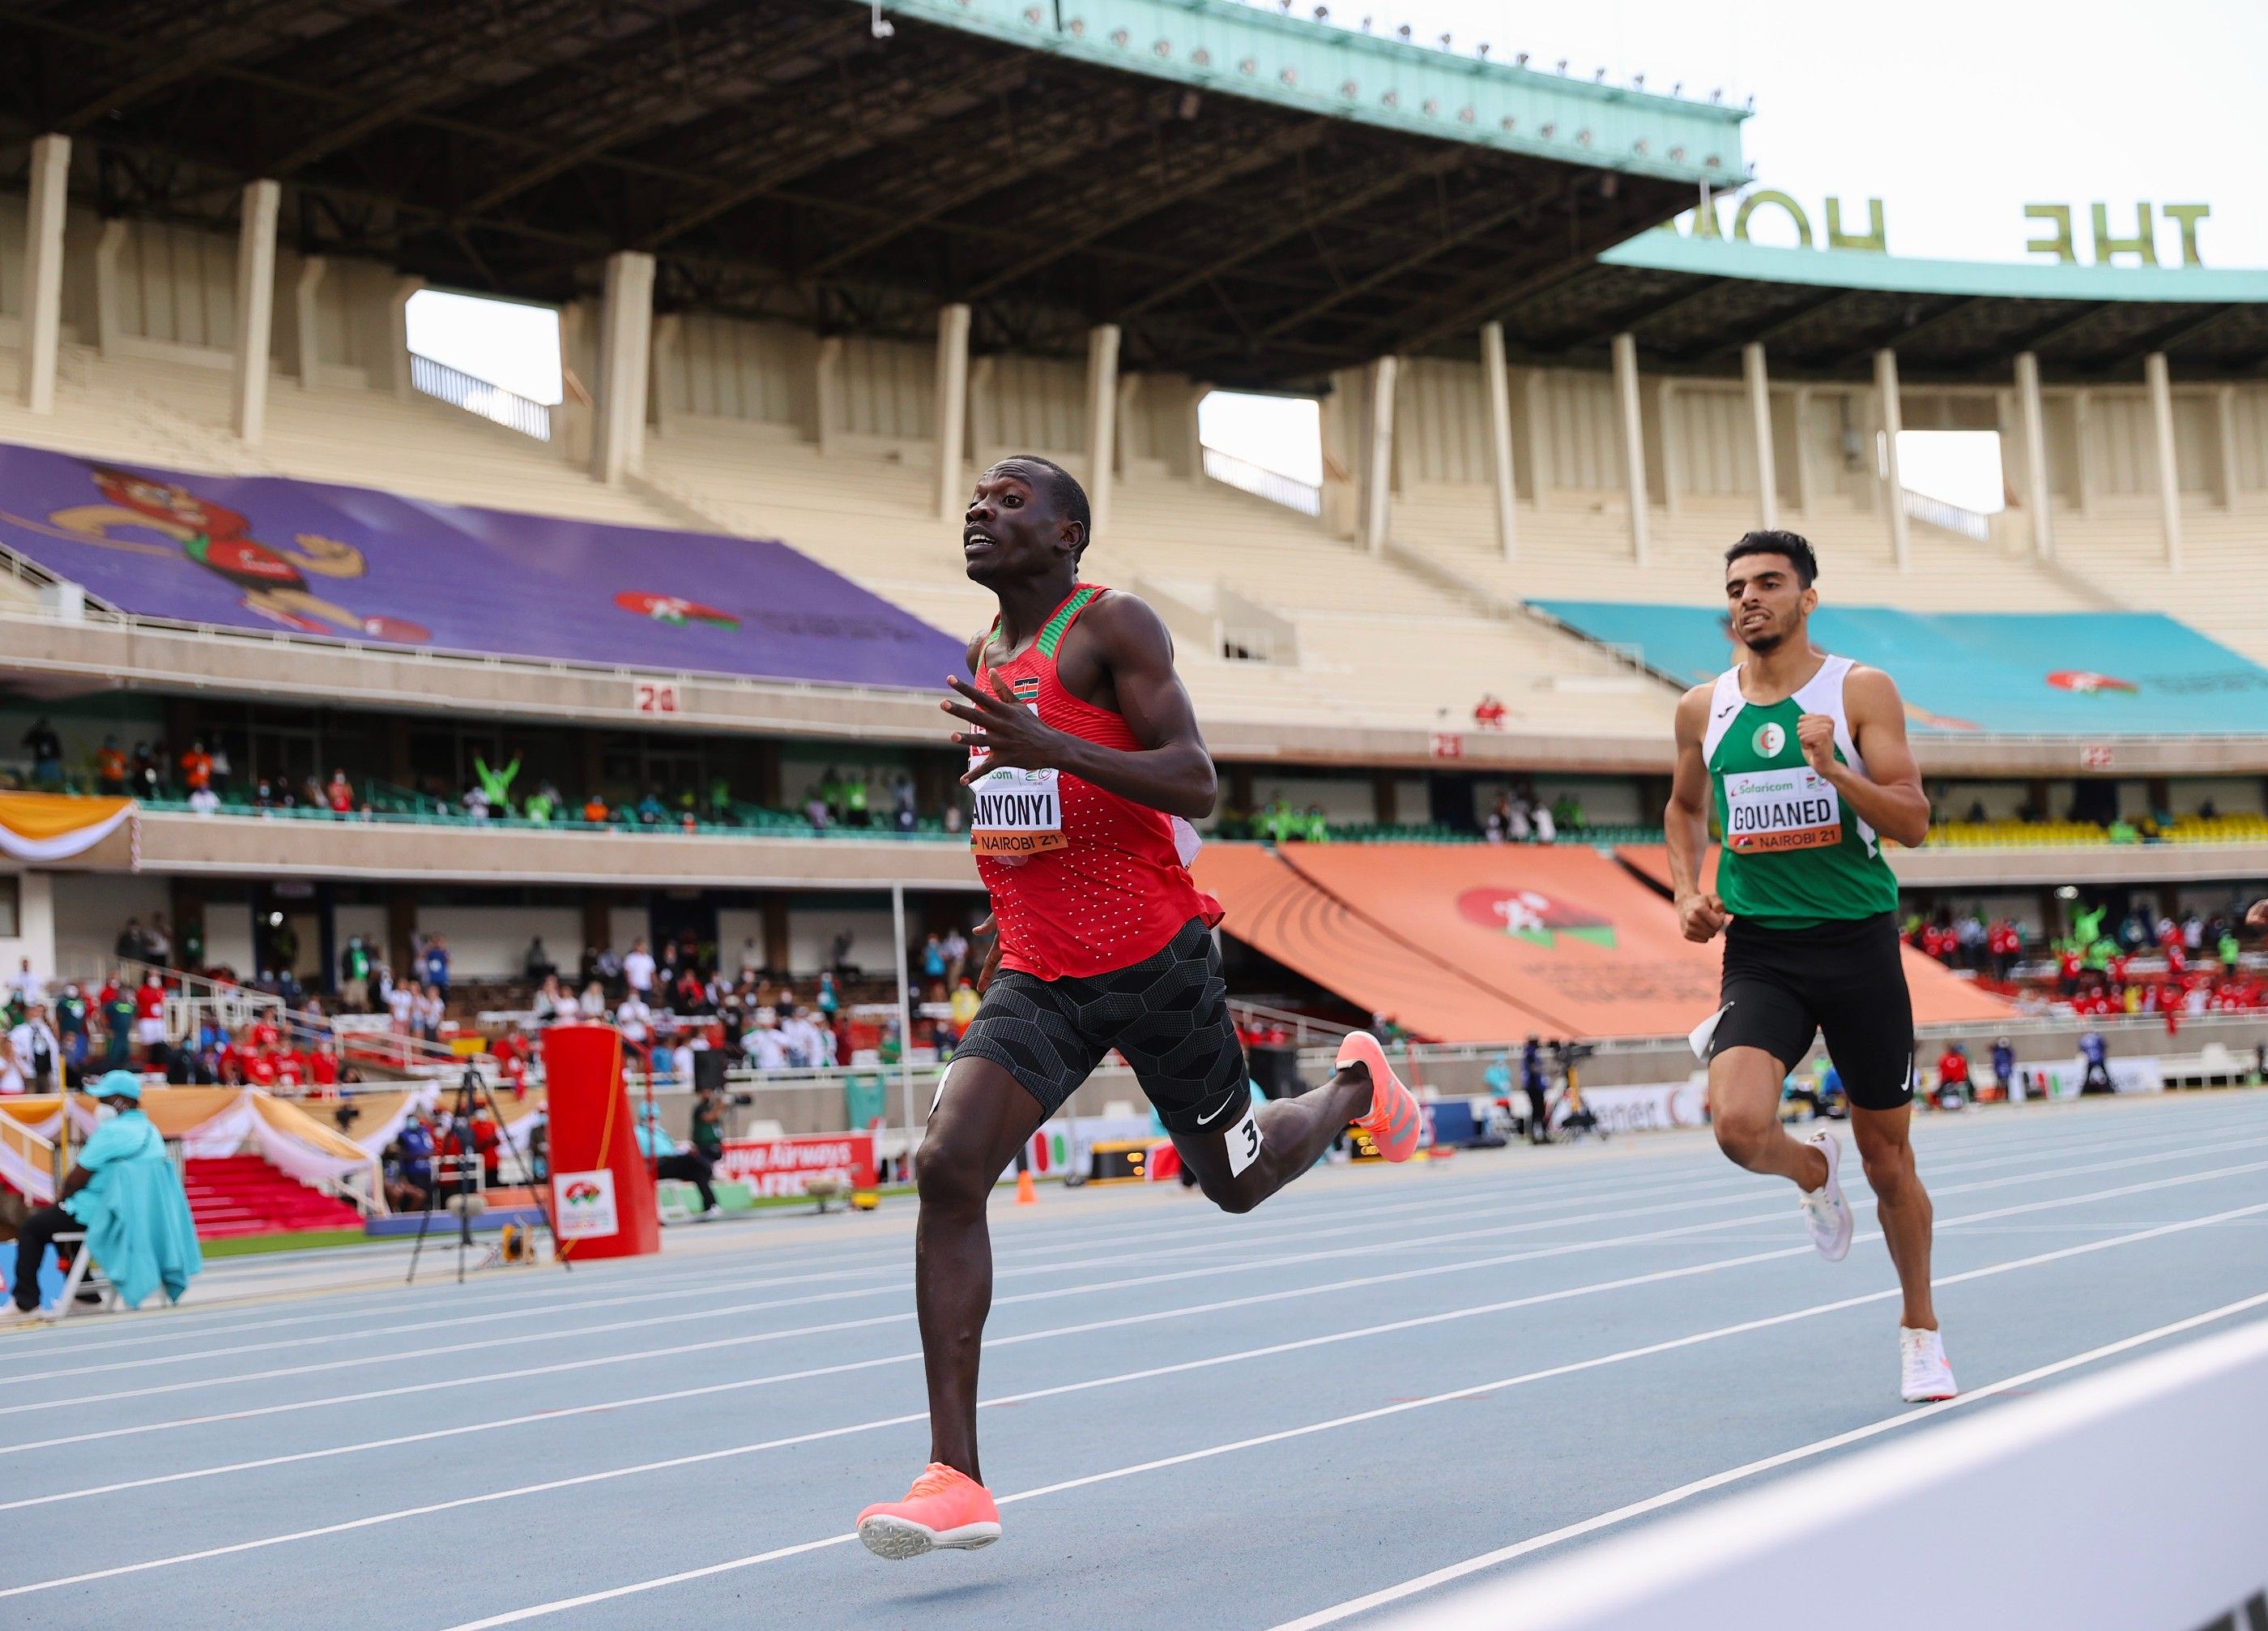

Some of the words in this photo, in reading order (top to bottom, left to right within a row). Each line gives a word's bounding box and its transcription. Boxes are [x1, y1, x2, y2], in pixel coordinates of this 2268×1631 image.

[1739, 781, 1793, 795] Safaricom
[1734, 799, 1831, 830] GOUANED
[982, 836, 1035, 851] NAIROBI
[1038, 834, 1059, 847] 21
[1759, 834, 1816, 848] NAIROBI
[1820, 830, 1835, 842] 21
[1242, 1119, 1258, 1159] 3
